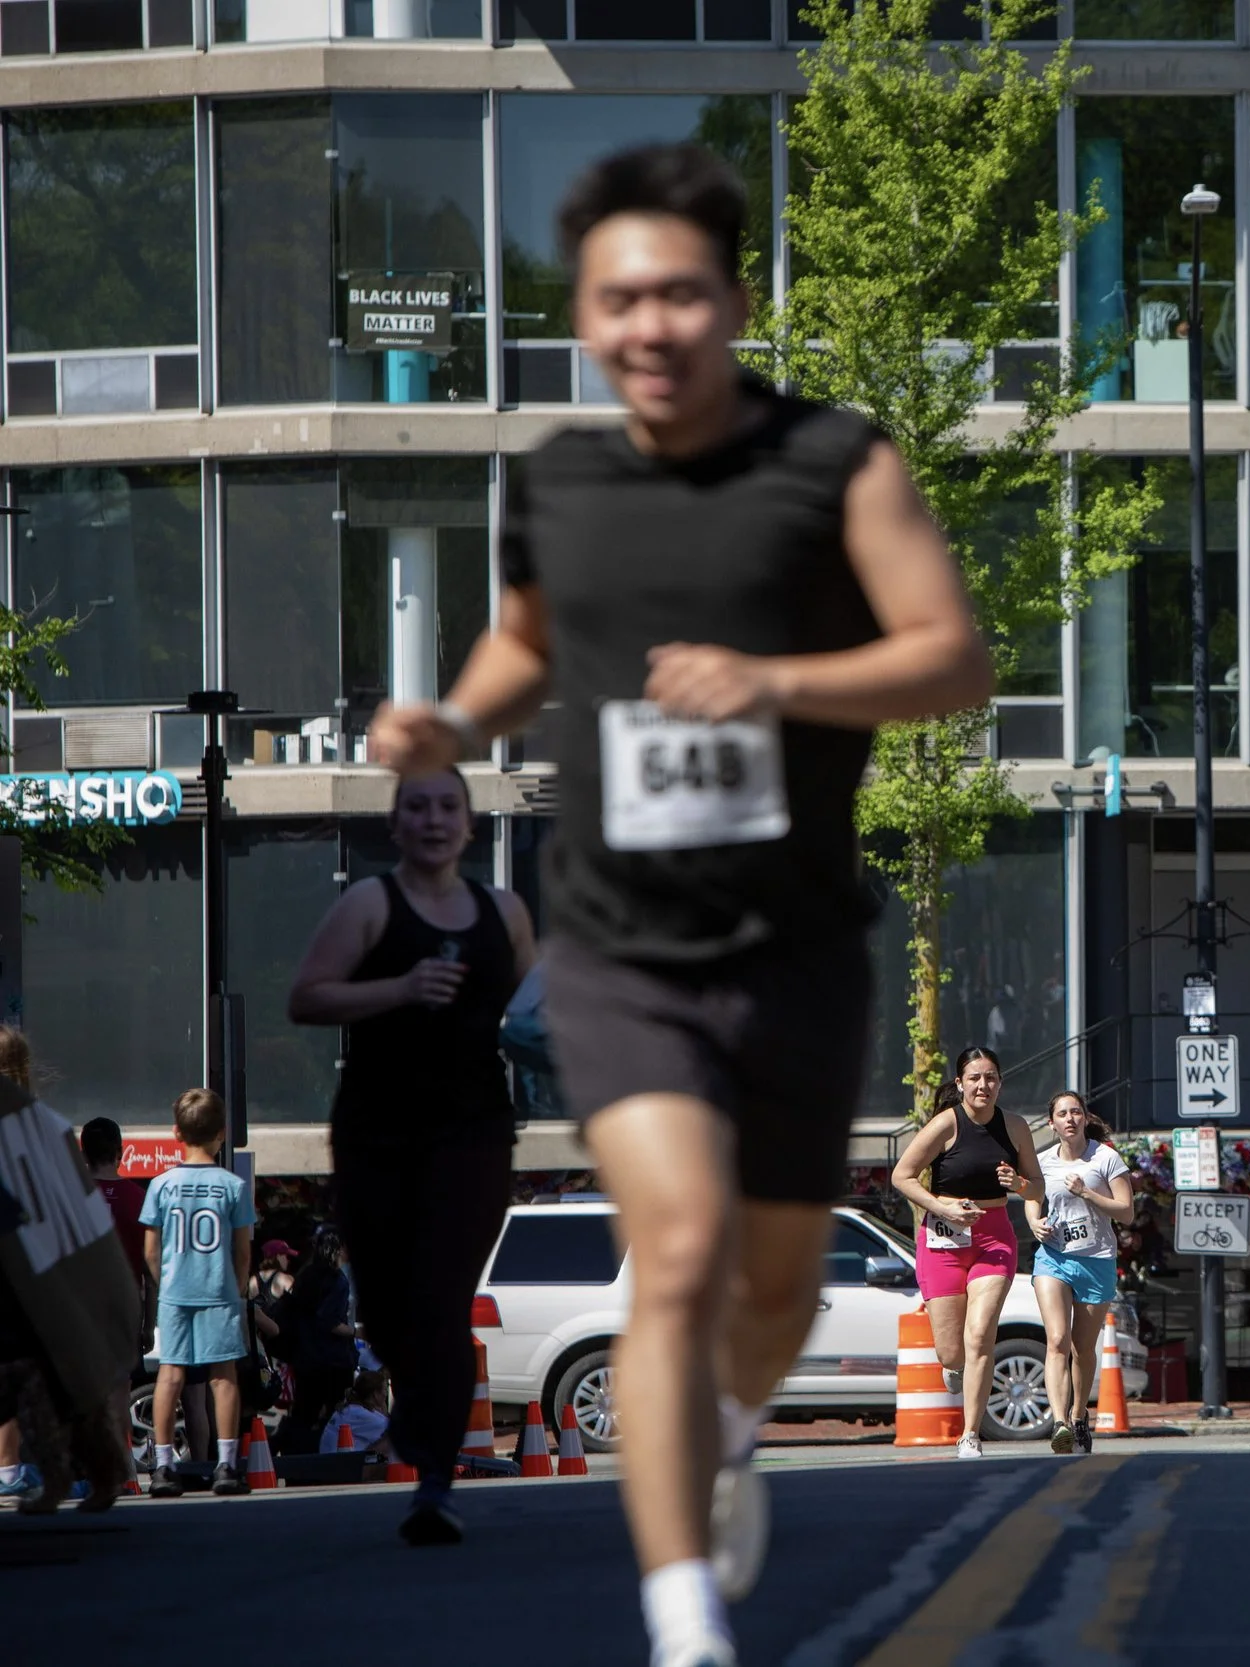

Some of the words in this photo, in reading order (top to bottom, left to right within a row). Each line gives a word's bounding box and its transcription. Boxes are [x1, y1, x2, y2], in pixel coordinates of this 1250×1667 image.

[349, 288, 403, 305] BLACK
[405, 290, 450, 307] LIVES
[366, 316, 433, 331] MATTER
[1186, 1044, 1229, 1062] ONE
[1185, 1065, 1230, 1084] WAY
[164, 1184, 227, 1199] MESS
[1183, 1202, 1245, 1219] EXCEPT
[170, 1207, 220, 1254] 10
[935, 1221, 961, 1238] 60
[1063, 1224, 1088, 1243] 553
